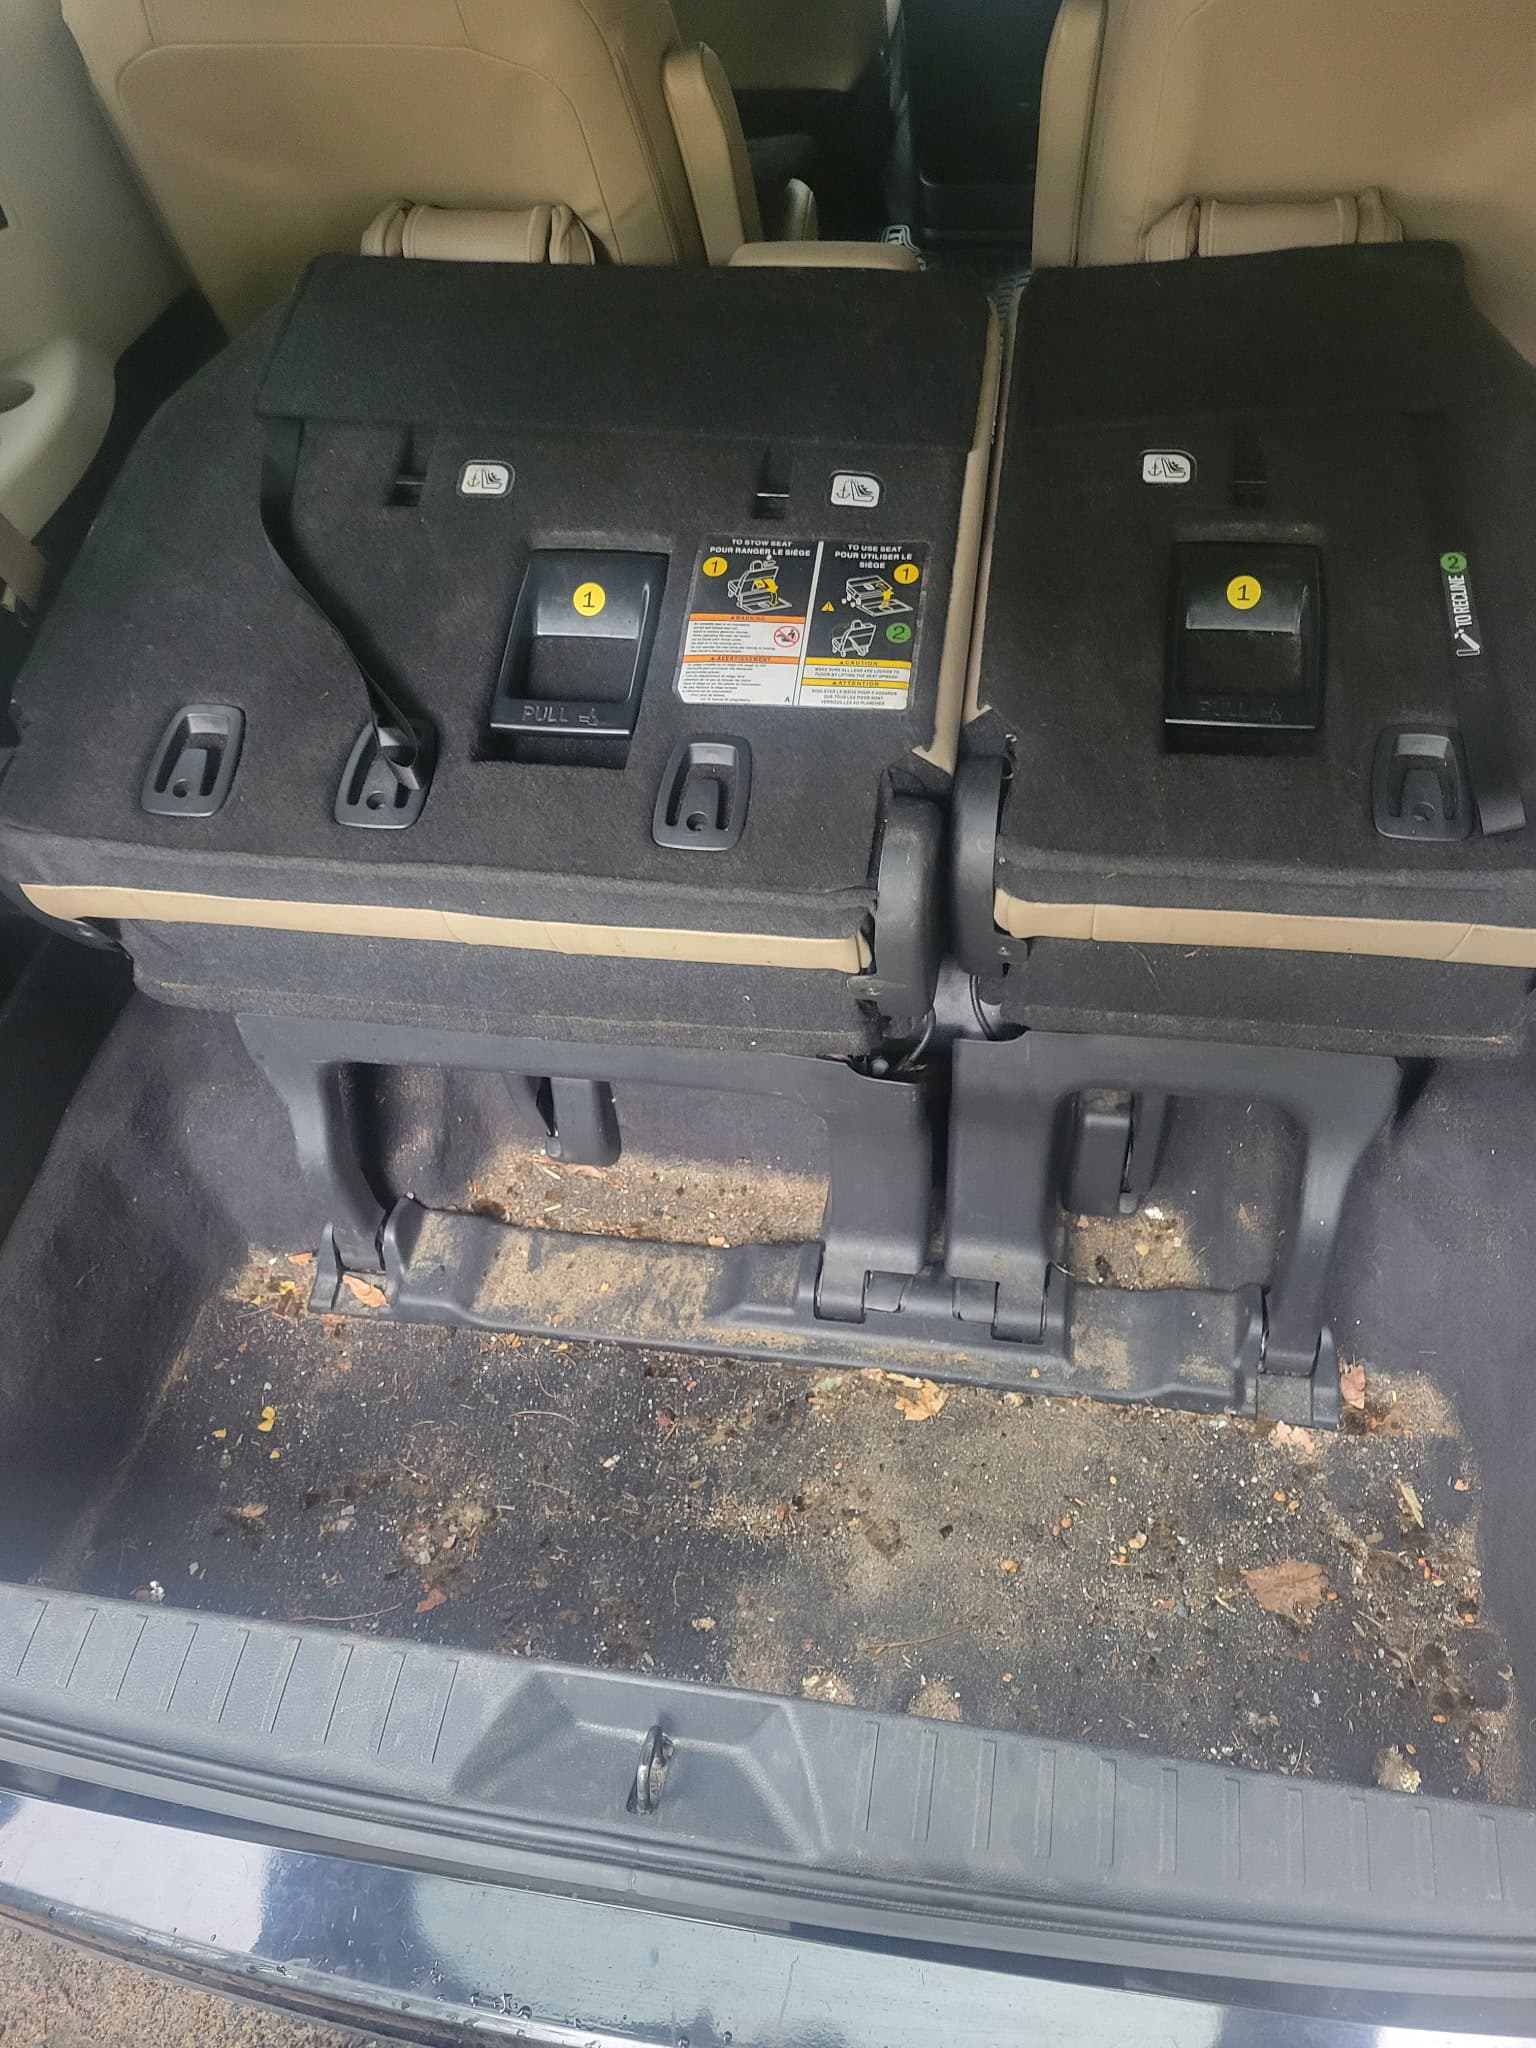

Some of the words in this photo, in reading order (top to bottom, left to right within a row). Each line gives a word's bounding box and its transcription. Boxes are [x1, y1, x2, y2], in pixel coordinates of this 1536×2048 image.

[709, 546, 733, 554] POUR
[735, 547, 771, 555] RANGER
[834, 551, 859, 559] POUR
[861, 552, 899, 560] UTILISER
[711, 560, 718, 574] 1
[1448, 556, 1459, 569] 2
[903, 567, 909, 581] 1
[1237, 583, 1250, 601] 1
[1448, 575, 1470, 614] RECLINE
[583, 590, 595, 610] 1
[1454, 613, 1473, 628] TO
[892, 625, 905, 640] 2
[520, 706, 568, 722] PULL
